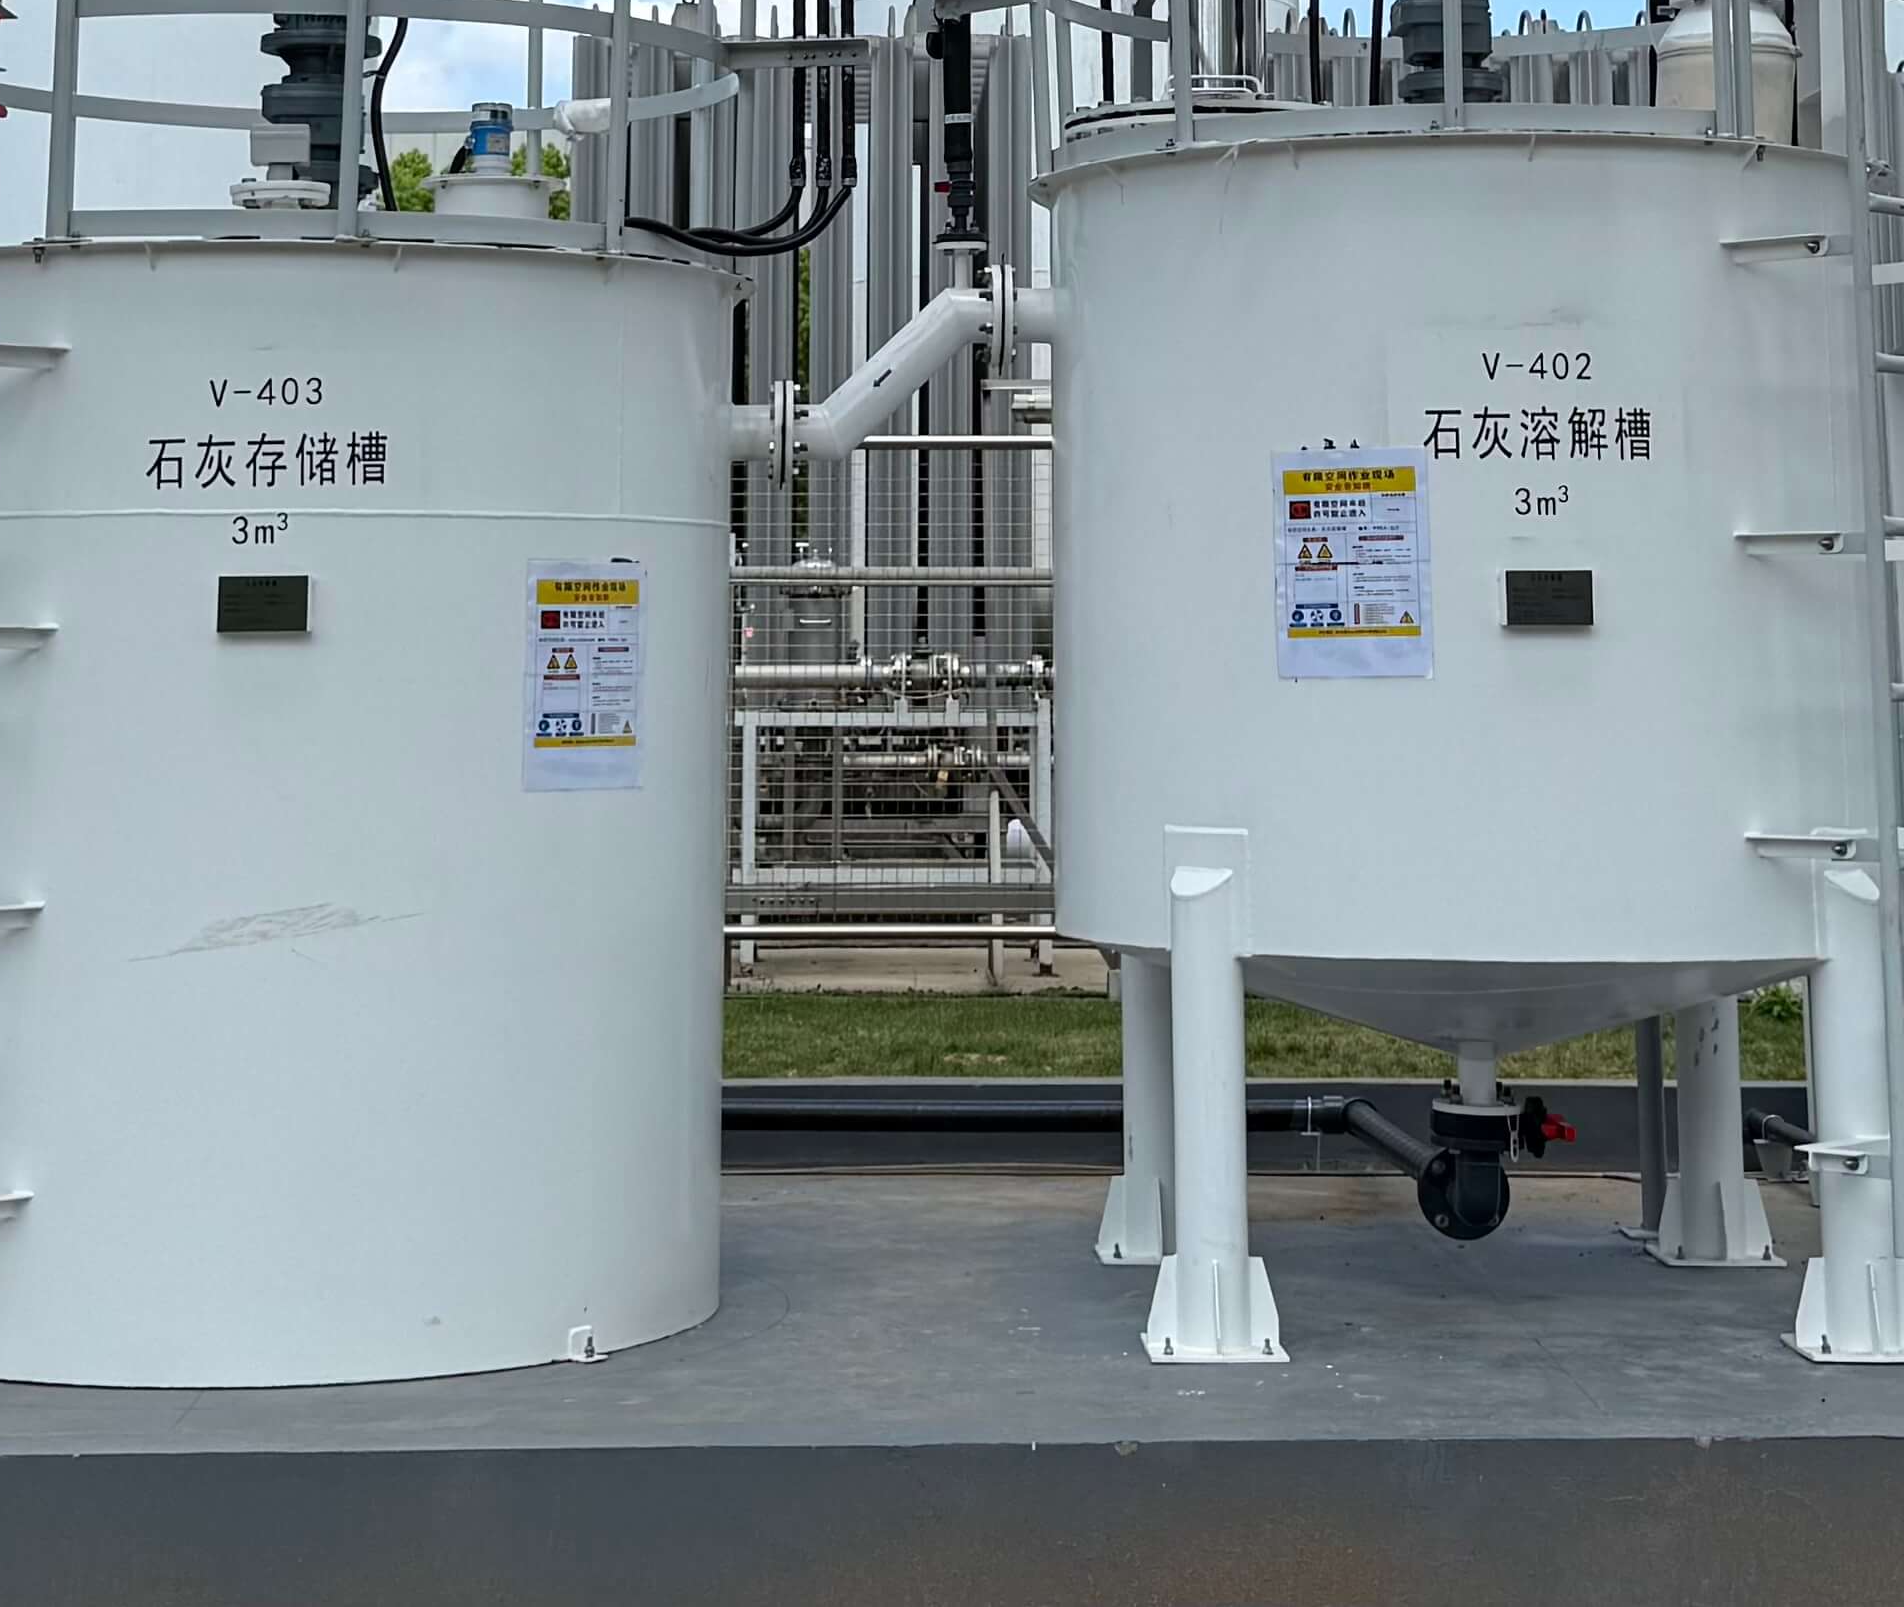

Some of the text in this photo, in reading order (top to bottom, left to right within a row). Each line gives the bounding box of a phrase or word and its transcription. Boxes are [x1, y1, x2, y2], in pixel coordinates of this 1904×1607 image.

[1481, 352, 1592, 381] V-402
[209, 377, 324, 408] V-403
[1423, 406, 1652, 461] 石灰溶解槽
[145, 430, 389, 491] 石灰存储槽
